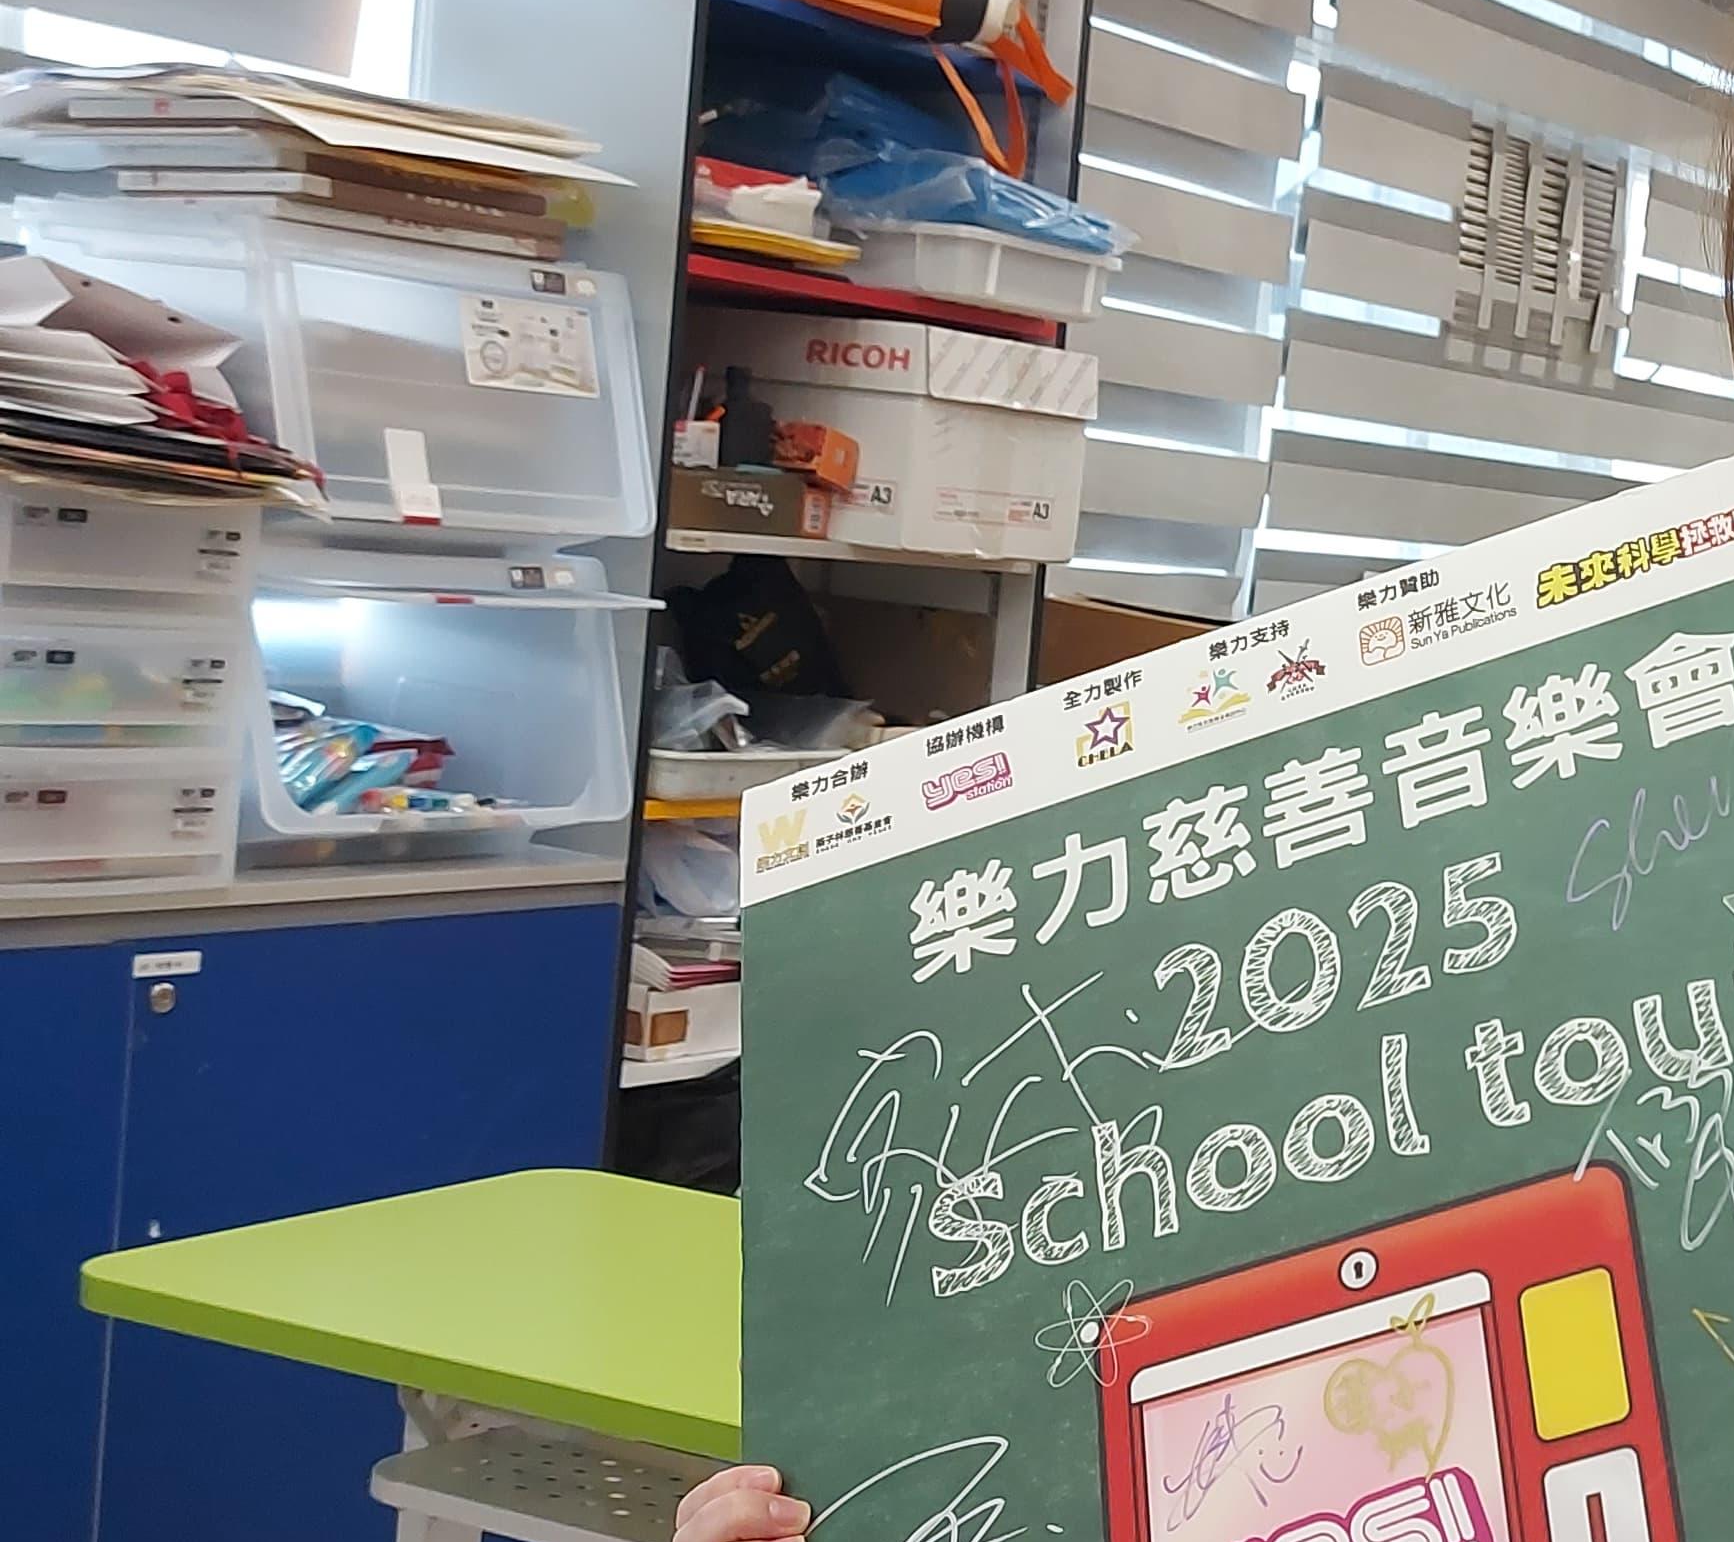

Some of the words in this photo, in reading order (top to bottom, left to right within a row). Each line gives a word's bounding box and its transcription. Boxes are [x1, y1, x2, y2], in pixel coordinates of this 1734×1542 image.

[805, 338, 911, 371] RICOH
[870, 484, 893, 506] A3
[1032, 502, 1051, 521] A3
[1408, 582, 1512, 635] 新雅文化
[1410, 632, 1434, 650] Sun
[1433, 628, 1450, 644] Ya
[1451, 607, 1518, 637] Publications
[1209, 619, 1290, 661] 樂力支持
[1063, 669, 1143, 711] 全力製作
[791, 760, 869, 802] 樂力合辦
[922, 752, 1011, 810] yes!
[966, 775, 1013, 801] station
[1155, 854, 1520, 1070] 2025
